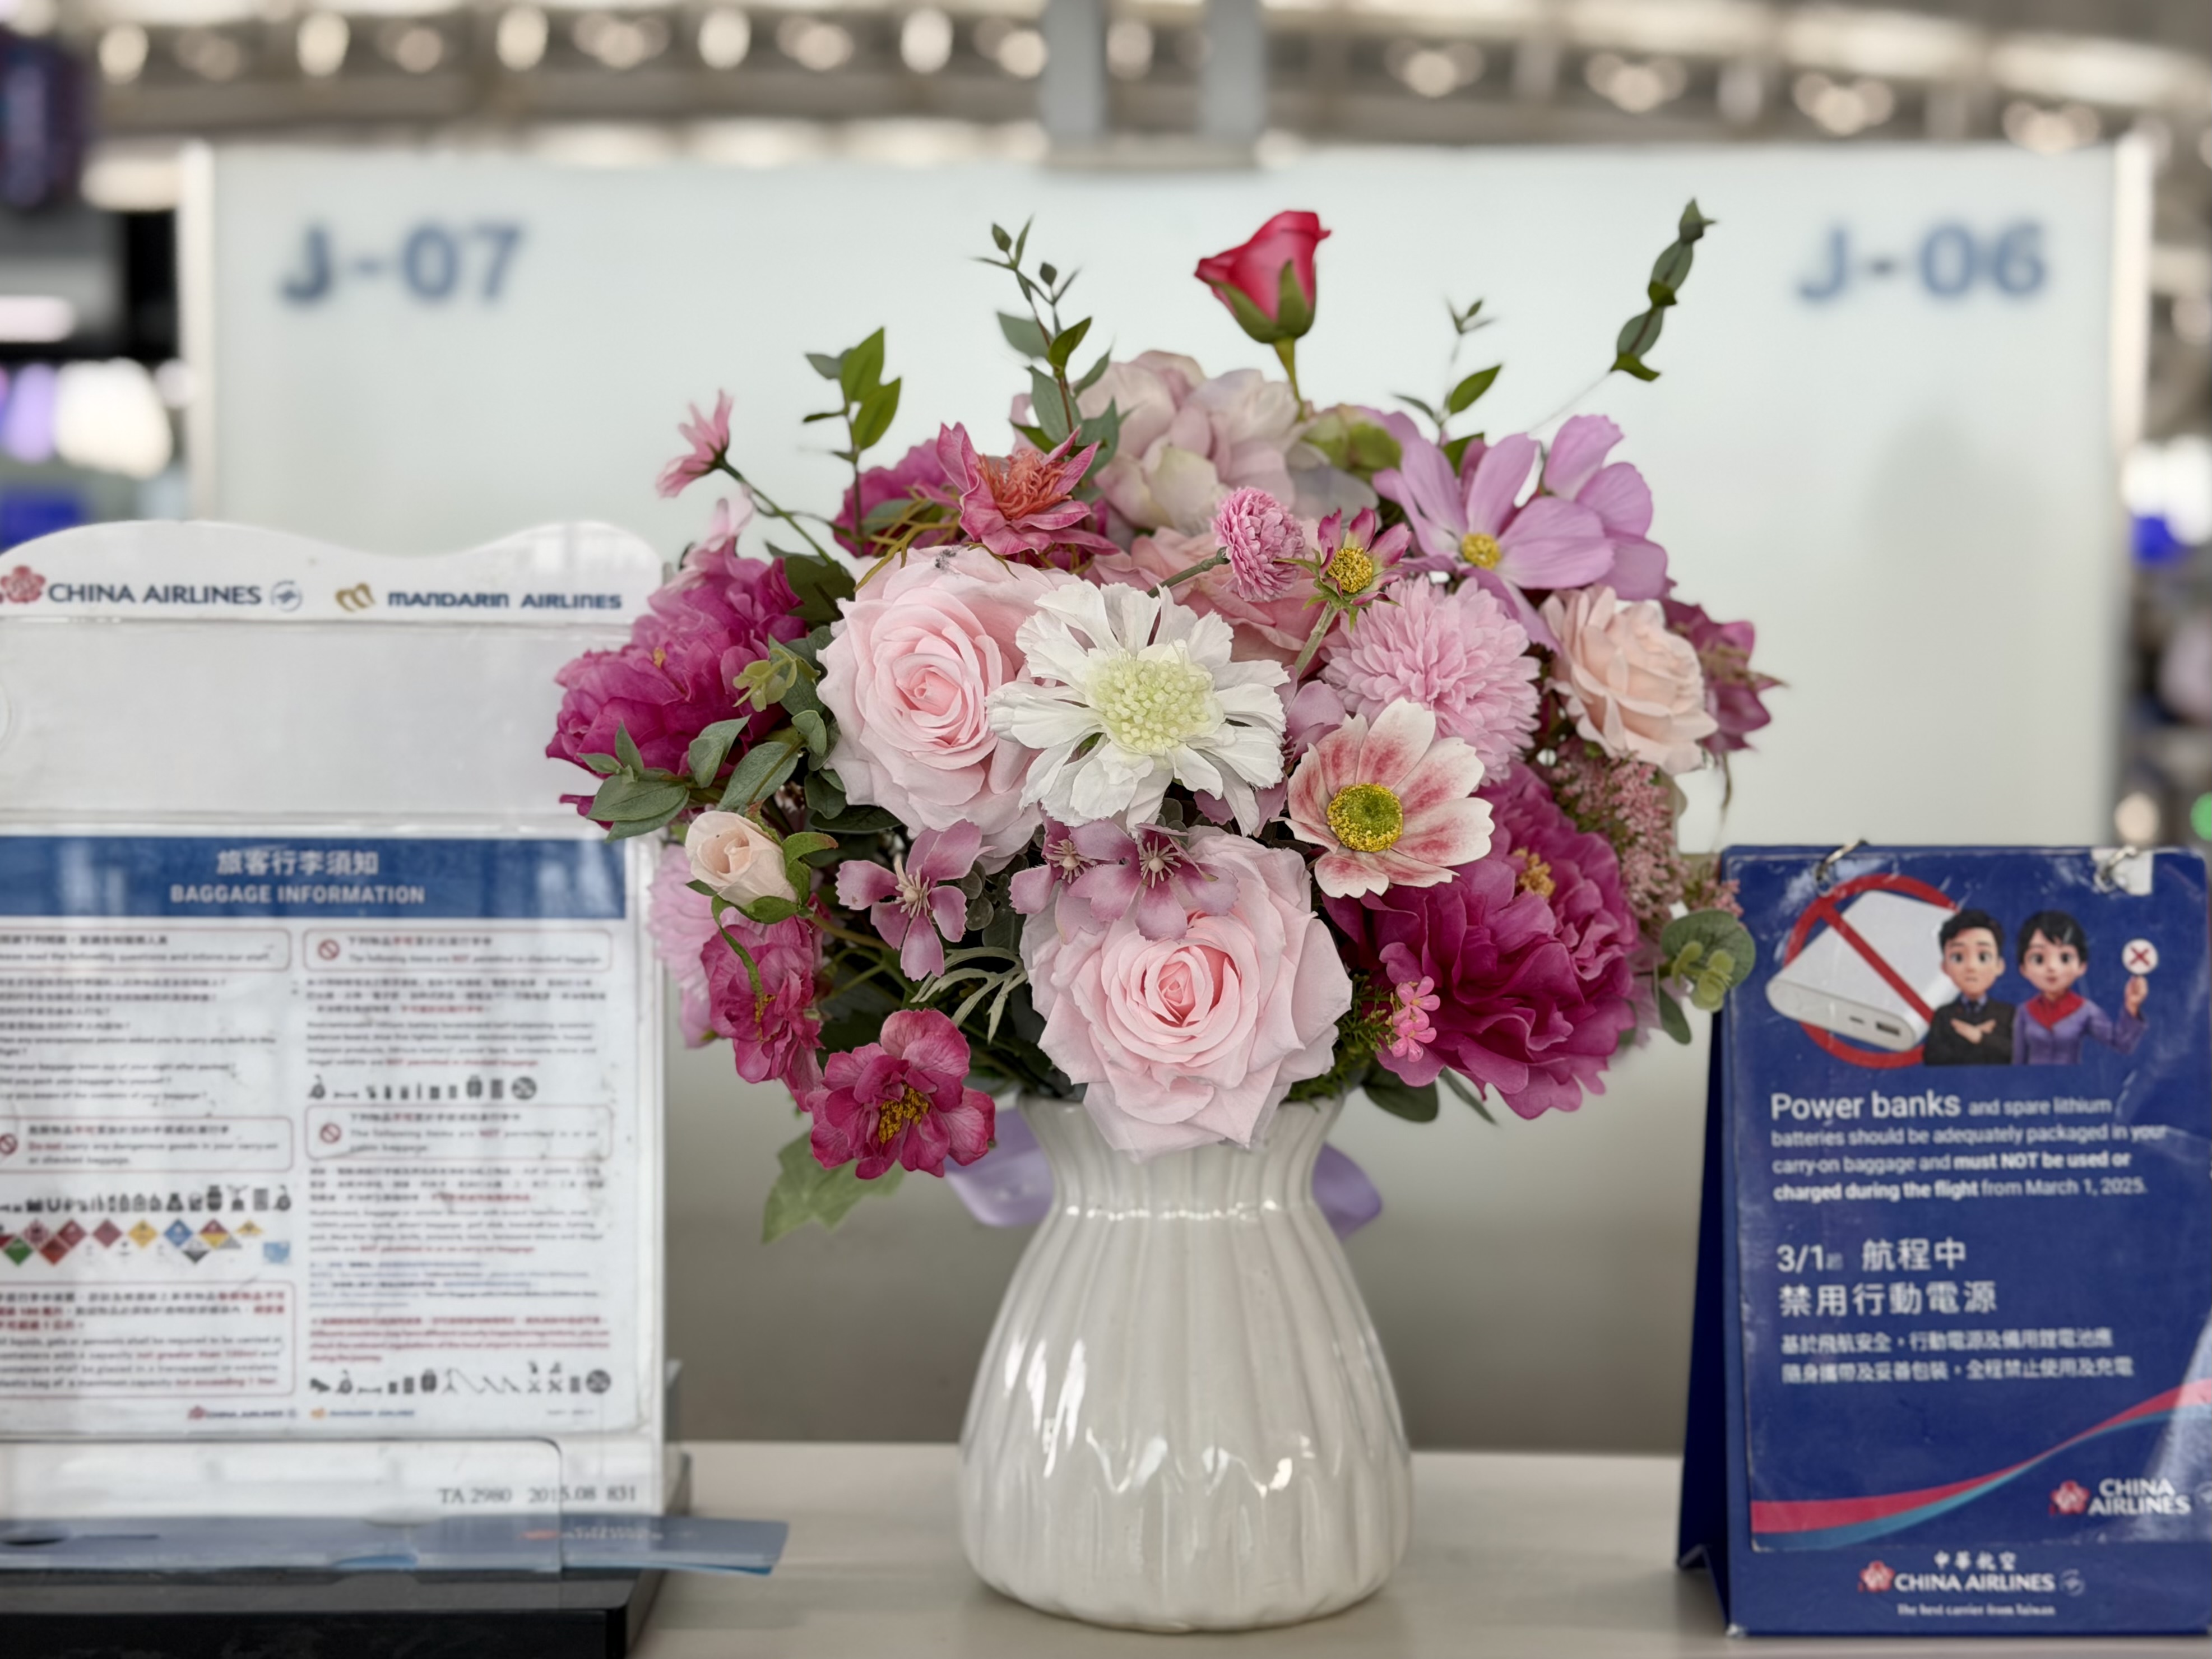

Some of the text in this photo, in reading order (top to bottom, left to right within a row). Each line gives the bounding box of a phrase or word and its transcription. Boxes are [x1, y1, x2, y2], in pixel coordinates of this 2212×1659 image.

[284, 223, 526, 305] J-07
[1797, 222, 2049, 305] J-06
[48, 583, 262, 605] CHINA AIRLINES
[388, 592, 622, 610] MANDARIN AIRLINES
[216, 850, 378, 875] 旅客行李須知
[170, 884, 425, 904] BAGGAGE INFORMATION
[1770, 1089, 2112, 1120] Power banks and spare lithium
[1771, 1122, 2167, 1147] batteries should be adequately packaged in your
[1772, 1149, 2131, 1176] carry-on baggage and must NOT be used or
[1773, 1175, 2148, 1203] charged during the flight from March 1, 2025.
[1862, 1236, 1966, 1271] 航程中
[1779, 1279, 1997, 1318] 禁用行動電源
[437, 1489, 465, 1504] TA
[2099, 1479, 2175, 1496] CHINA
[2088, 1496, 2191, 1516] AIRLINES
[1895, 1573, 2055, 1592] CHINA AIRLINES
[2016, 1605, 2056, 1615] Taiwan
